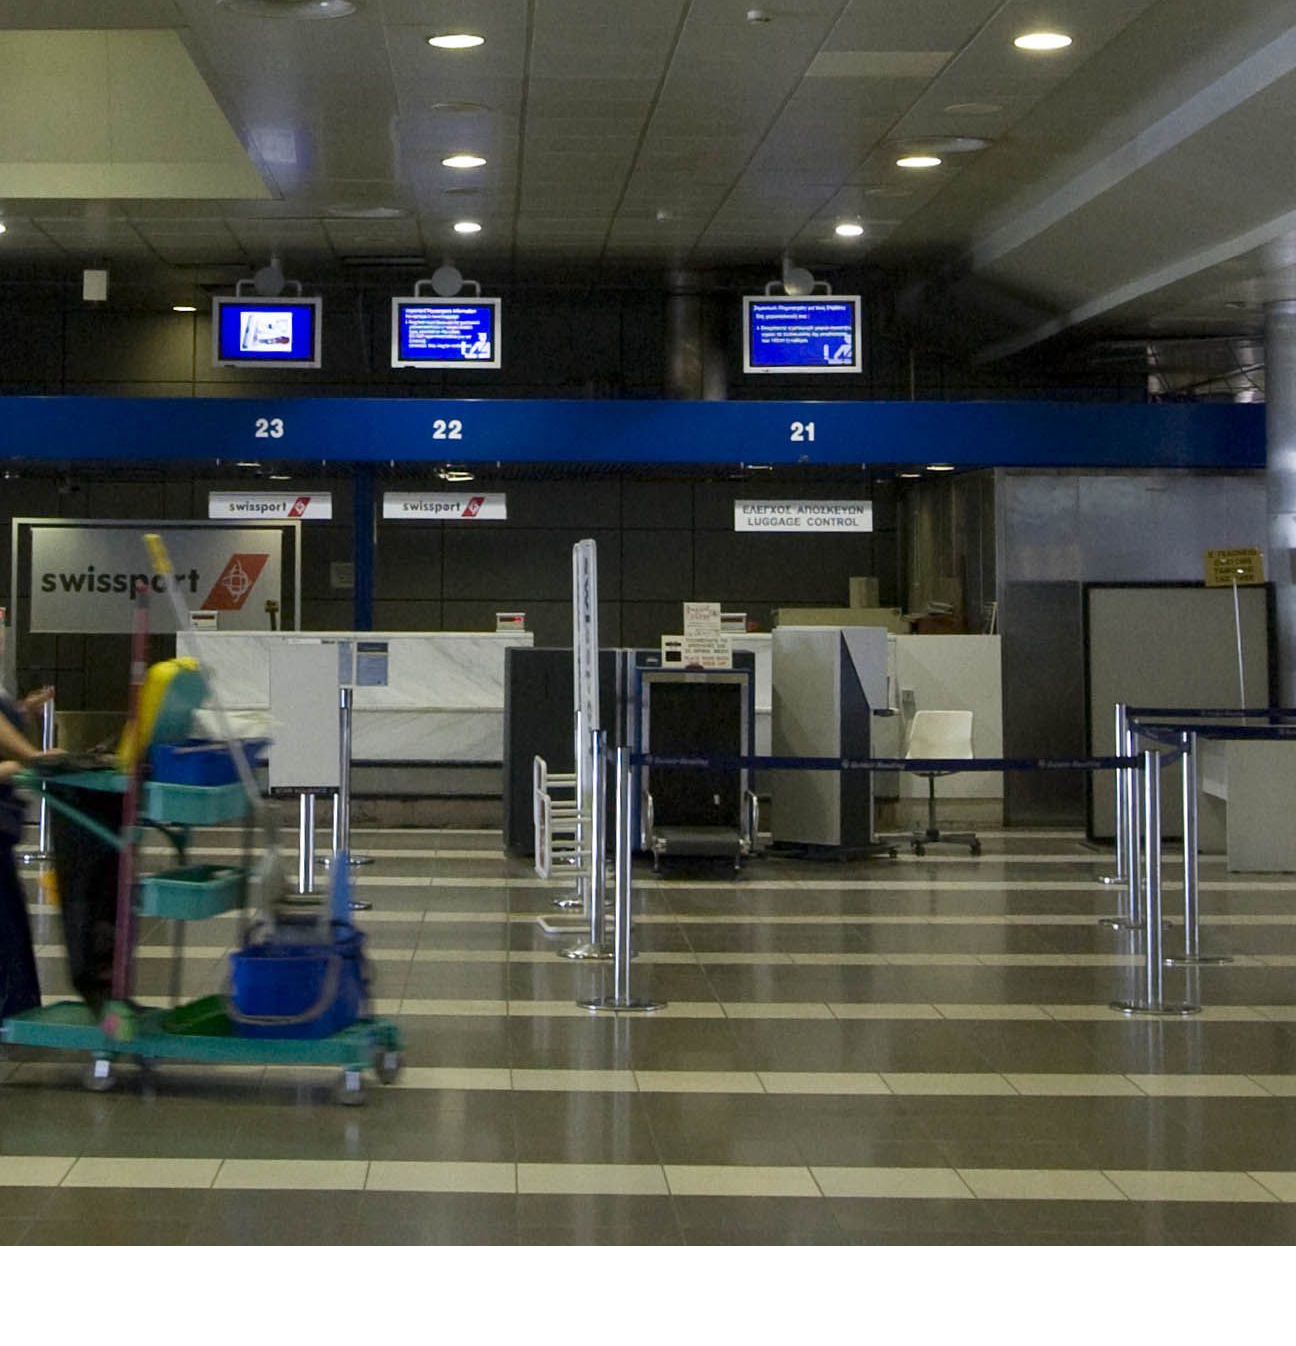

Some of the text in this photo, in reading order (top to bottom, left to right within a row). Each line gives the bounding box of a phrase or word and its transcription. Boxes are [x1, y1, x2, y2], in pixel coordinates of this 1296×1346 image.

[255, 418, 284, 439] 23
[432, 420, 463, 441] 22
[790, 421, 816, 443] 21
[229, 501, 286, 515] swissport
[402, 501, 460, 515] swissport
[748, 517, 859, 527] LUGGAGE CONTROL
